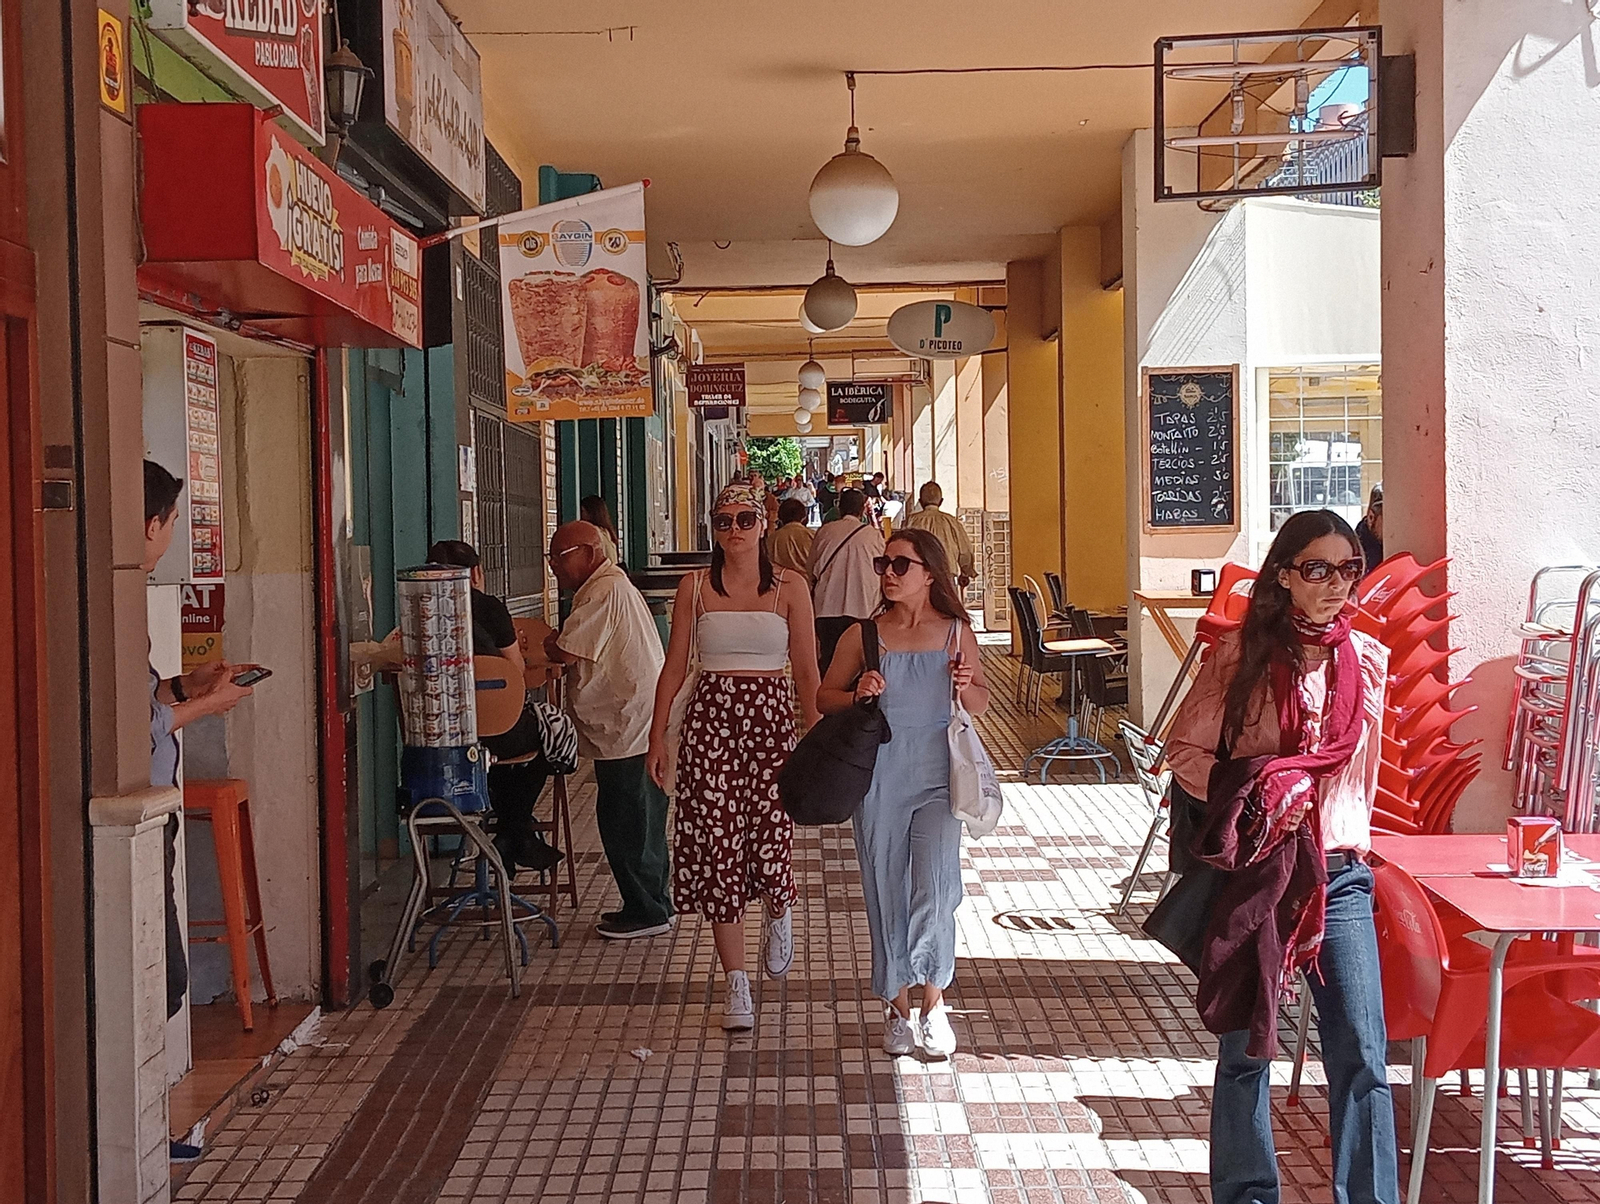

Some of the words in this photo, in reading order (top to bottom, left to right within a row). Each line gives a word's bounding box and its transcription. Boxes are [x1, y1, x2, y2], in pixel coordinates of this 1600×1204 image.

[254, 41, 279, 67] PABLO
[279, 44, 299, 69] RADA
[295, 159, 333, 222] HUEVO
[690, 372, 742, 382] JOYERIA
[690, 383, 744, 393] DOMINGUEZ
[831, 387, 844, 396] LA
[845, 385, 883, 396] IBÉRICA
[1154, 412, 1196, 426] TAPAS
[1151, 424, 1199, 441] MONTAITO
[1152, 456, 1195, 470] TERCIOS
[1154, 471, 1200, 487] MEDIAS
[1152, 488, 1202, 503] TORRIJAS
[1155, 508, 1198, 521] HABAS
[182, 613, 211, 623] nline
